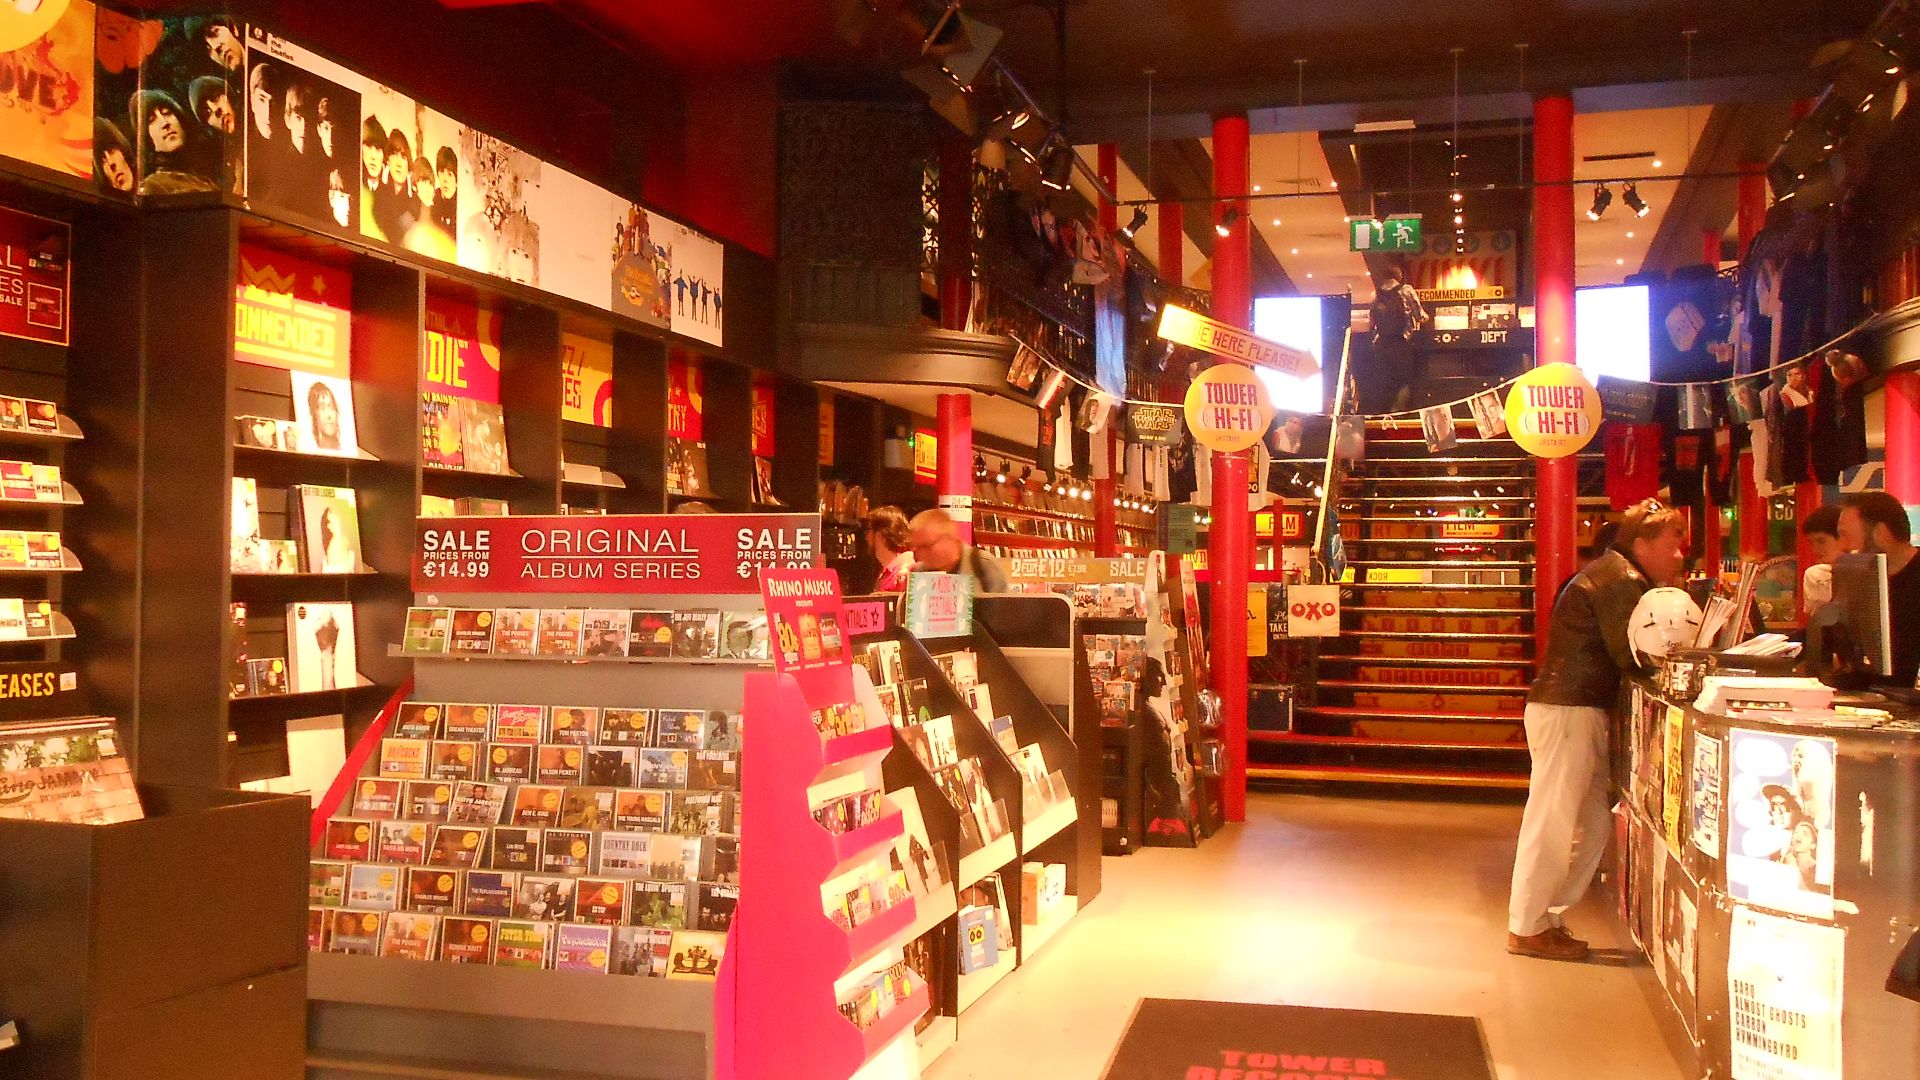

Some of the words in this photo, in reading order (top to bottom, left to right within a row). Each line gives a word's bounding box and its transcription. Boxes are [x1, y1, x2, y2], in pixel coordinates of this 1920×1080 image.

[1481, 331, 1507, 343] DEPT
[424, 330, 469, 389] DIE
[1212, 332, 1244, 355] HERE
[1249, 343, 1300, 371] PLEASE!
[562, 377, 581, 410] ES
[1205, 382, 1257, 406] TOWER
[1528, 385, 1585, 409] TOWER
[1134, 407, 1174, 417] STAR
[1214, 408, 1253, 431] HI-FI
[1135, 420, 1175, 430] WARS
[1537, 411, 1580, 435] HI-FI
[1269, 517, 1295, 529] FM
[424, 530, 490, 550] SALE
[521, 529, 699, 553] ORIGINAL
[737, 528, 811, 549] SALE
[423, 552, 459, 560] PRICES
[461, 552, 490, 560] FROM
[737, 551, 776, 560] PRICES
[780, 551, 811, 560] FROM
[423, 561, 490, 577] €14.99
[521, 563, 603, 578] ALBUM
[614, 562, 701, 579] SERIES
[736, 562, 811, 578] €1499
[1011, 558, 1021, 577] 2
[1021, 563, 1038, 573] FOR
[1110, 561, 1145, 577] SALE
[768, 578, 803, 597] RHINO
[804, 578, 834, 597] MUSIC
[1291, 601, 1335, 621] OXO
[1269, 623, 1287, 633] TAKE
[0, 673, 54, 699] EASES
[1735, 995, 1766, 1018] ALMOST
[1769, 1006, 1806, 1029] GHOSTS
[1220, 1050, 1387, 1076] TOWER
